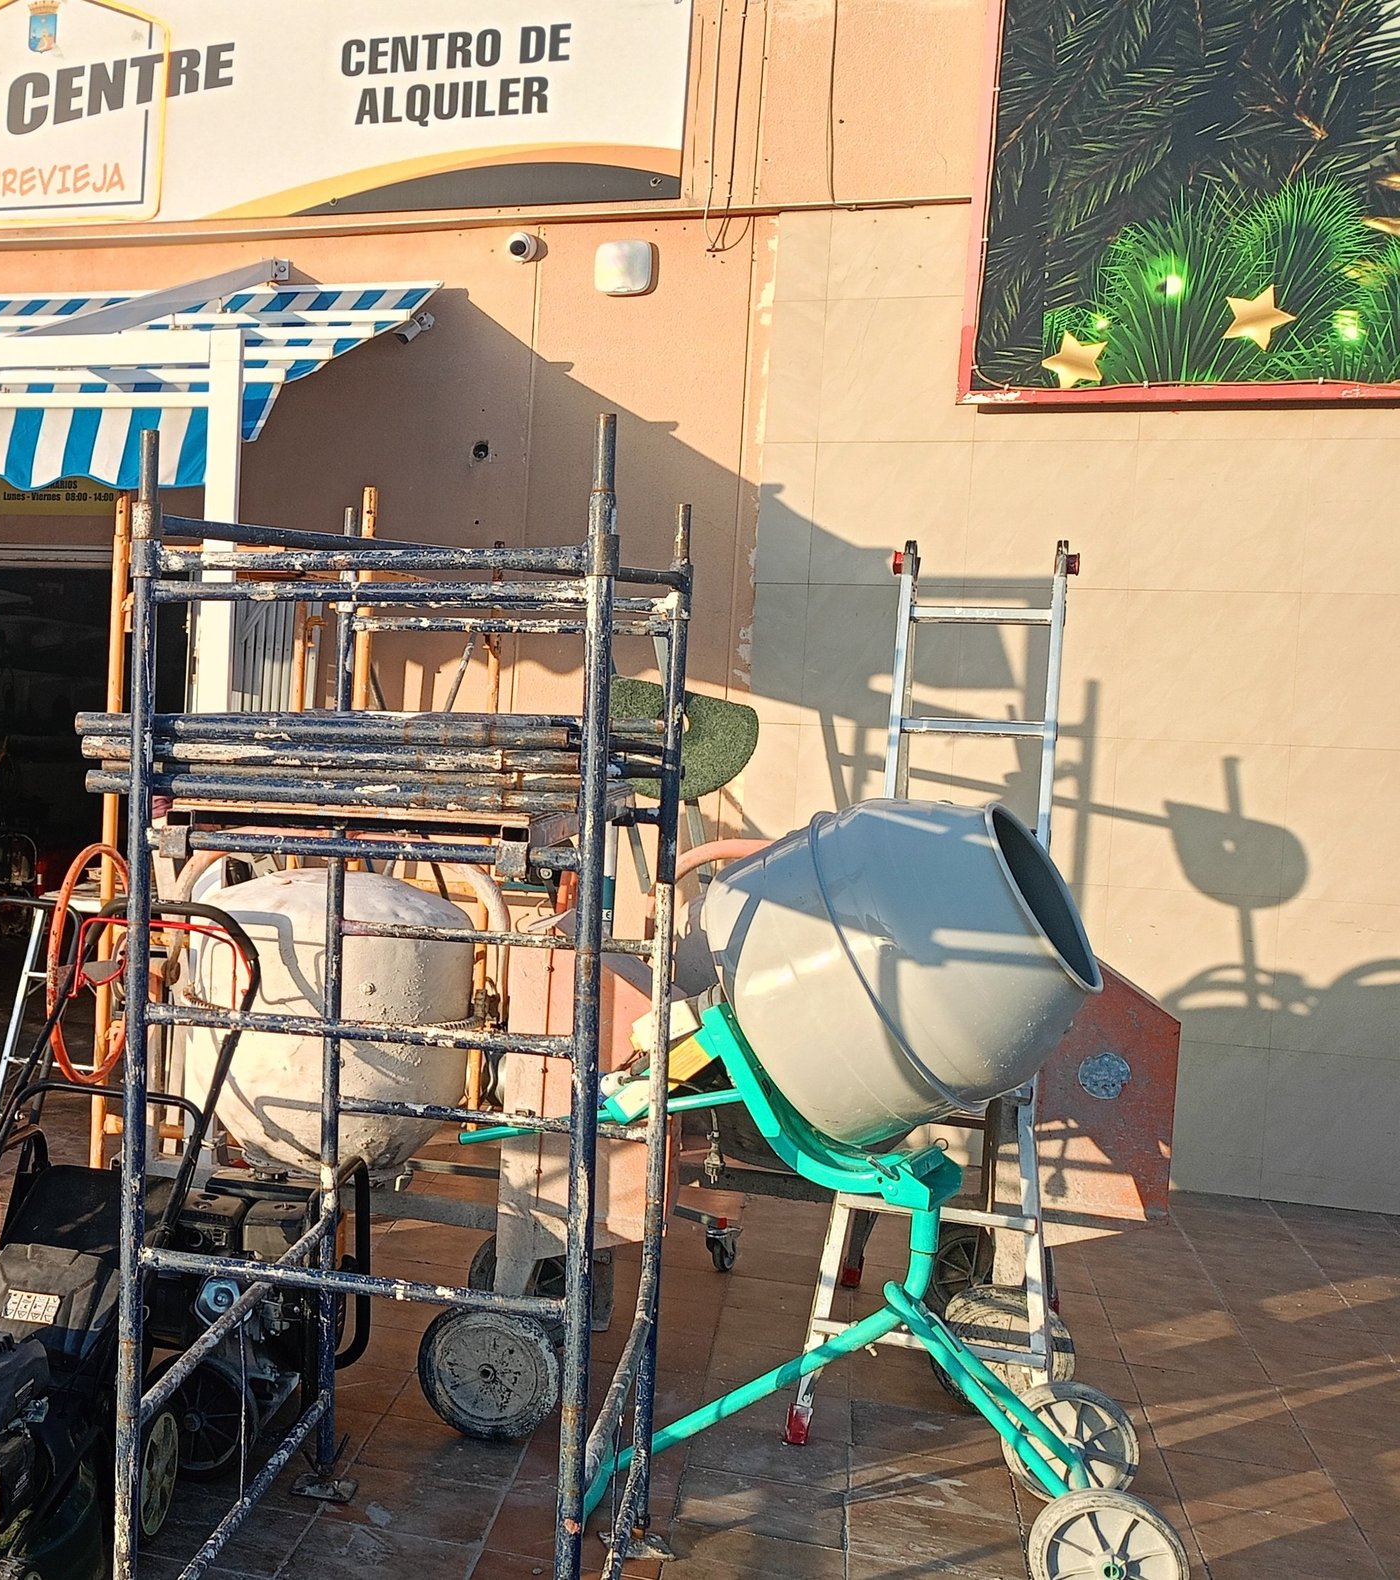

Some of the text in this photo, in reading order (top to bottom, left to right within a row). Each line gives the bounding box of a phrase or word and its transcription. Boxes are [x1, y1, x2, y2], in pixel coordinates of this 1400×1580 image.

[341, 23, 572, 77] CENTRO DE
[6, 42, 235, 136] CENTRE
[355, 76, 549, 127] ALQUILER
[3, 491, 26, 501] Lunes
[31, 491, 61, 501] Viernes
